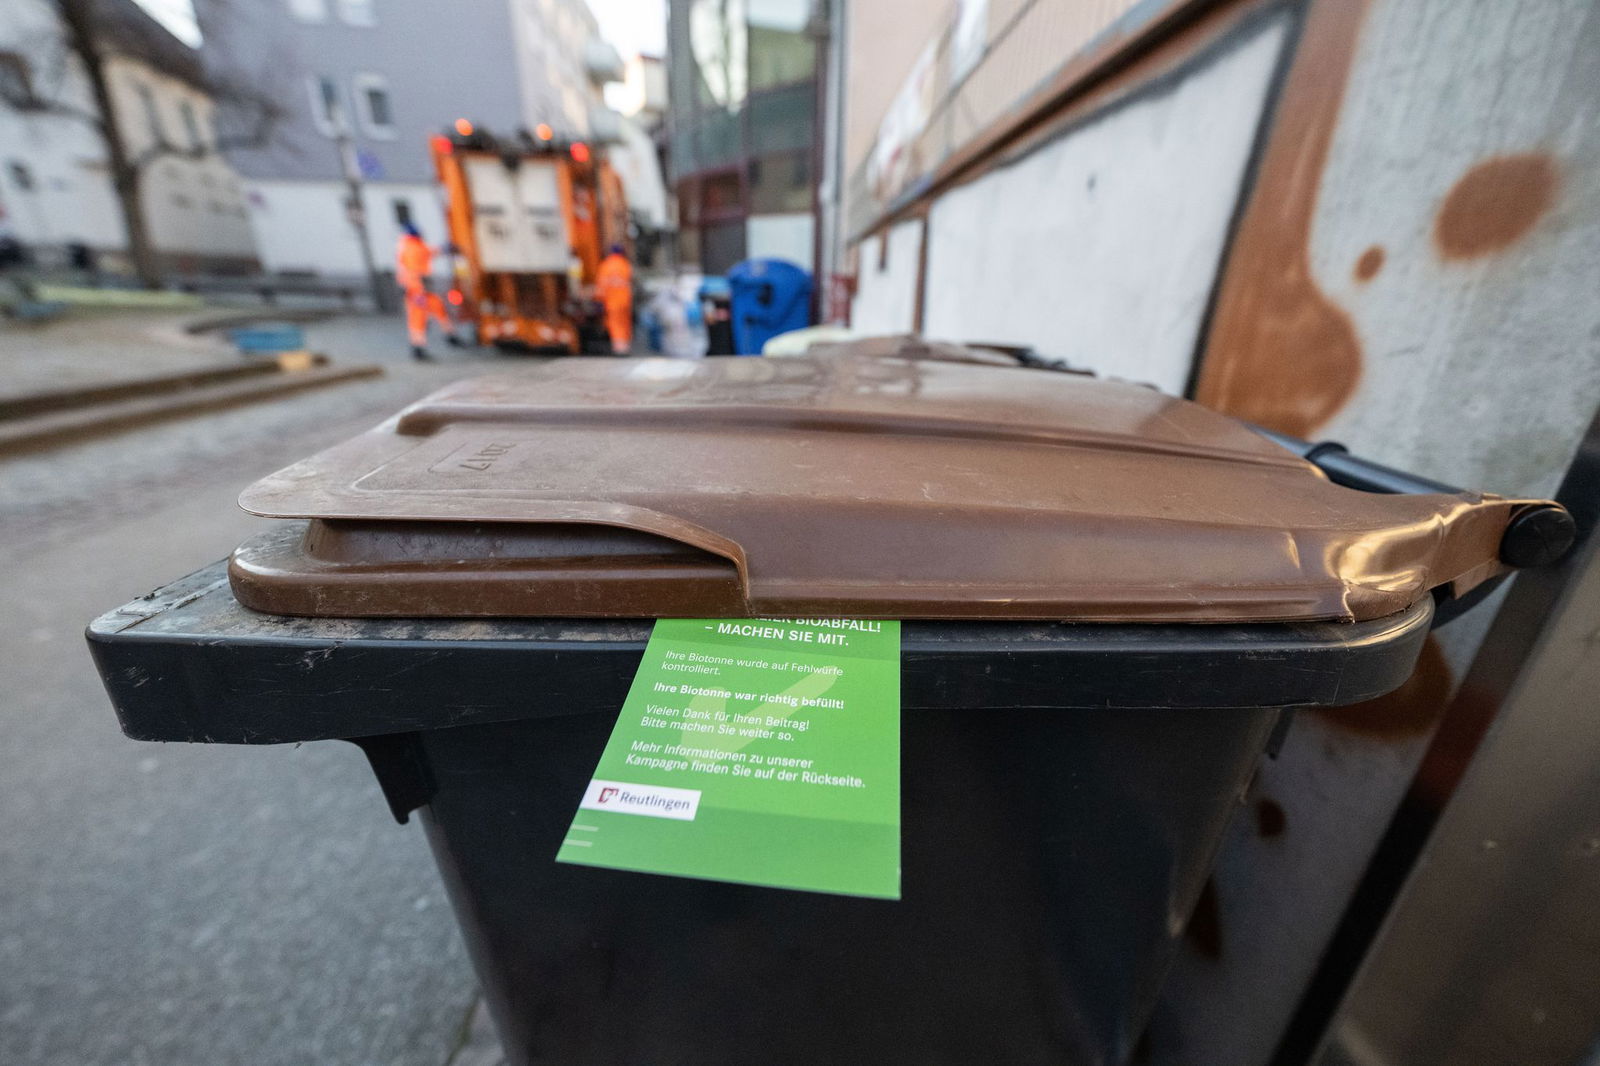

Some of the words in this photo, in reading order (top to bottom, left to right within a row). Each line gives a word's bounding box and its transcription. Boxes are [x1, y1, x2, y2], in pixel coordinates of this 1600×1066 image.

[717, 622, 785, 639] MACHEN
[788, 630, 814, 642] SIE
[817, 633, 849, 646] MIT.
[795, 618, 881, 633] BIOABFALL!
[661, 661, 721, 675] kontrolliert.
[665, 650, 686, 660] Ihre
[688, 652, 734, 665] Biotonne
[736, 659, 769, 669] wurde
[771, 662, 789, 671] auf
[791, 662, 844, 676] Fehlwürfe
[653, 682, 677, 693] Ihre
[680, 684, 732, 699] Biotonne
[734, 692, 757, 701] war
[759, 693, 799, 707] richtig
[801, 696, 845, 709] befüllt!
[640, 716, 667, 728] Bitte
[669, 720, 715, 733] machen
[717, 724, 737, 735] Sie
[739, 727, 774, 739] weiter
[777, 732, 795, 741] so.
[646, 704, 680, 716] Vielen
[682, 707, 711, 720] Dank
[713, 711, 731, 721] für
[733, 713, 762, 725] Ihren
[765, 716, 810, 732] Beitrag!
[631, 740, 662, 753] Mehr
[664, 743, 746, 762] Informationen
[749, 753, 764, 764] zu
[766, 756, 814, 769] unserer
[625, 753, 689, 771] Kampagne
[691, 761, 729, 774] finden
[731, 764, 752, 777] Sie
[754, 768, 775, 779] auf
[777, 769, 799, 781] der
[801, 770, 866, 788] Rückseite.
[620, 791, 691, 811] Reutlingen
